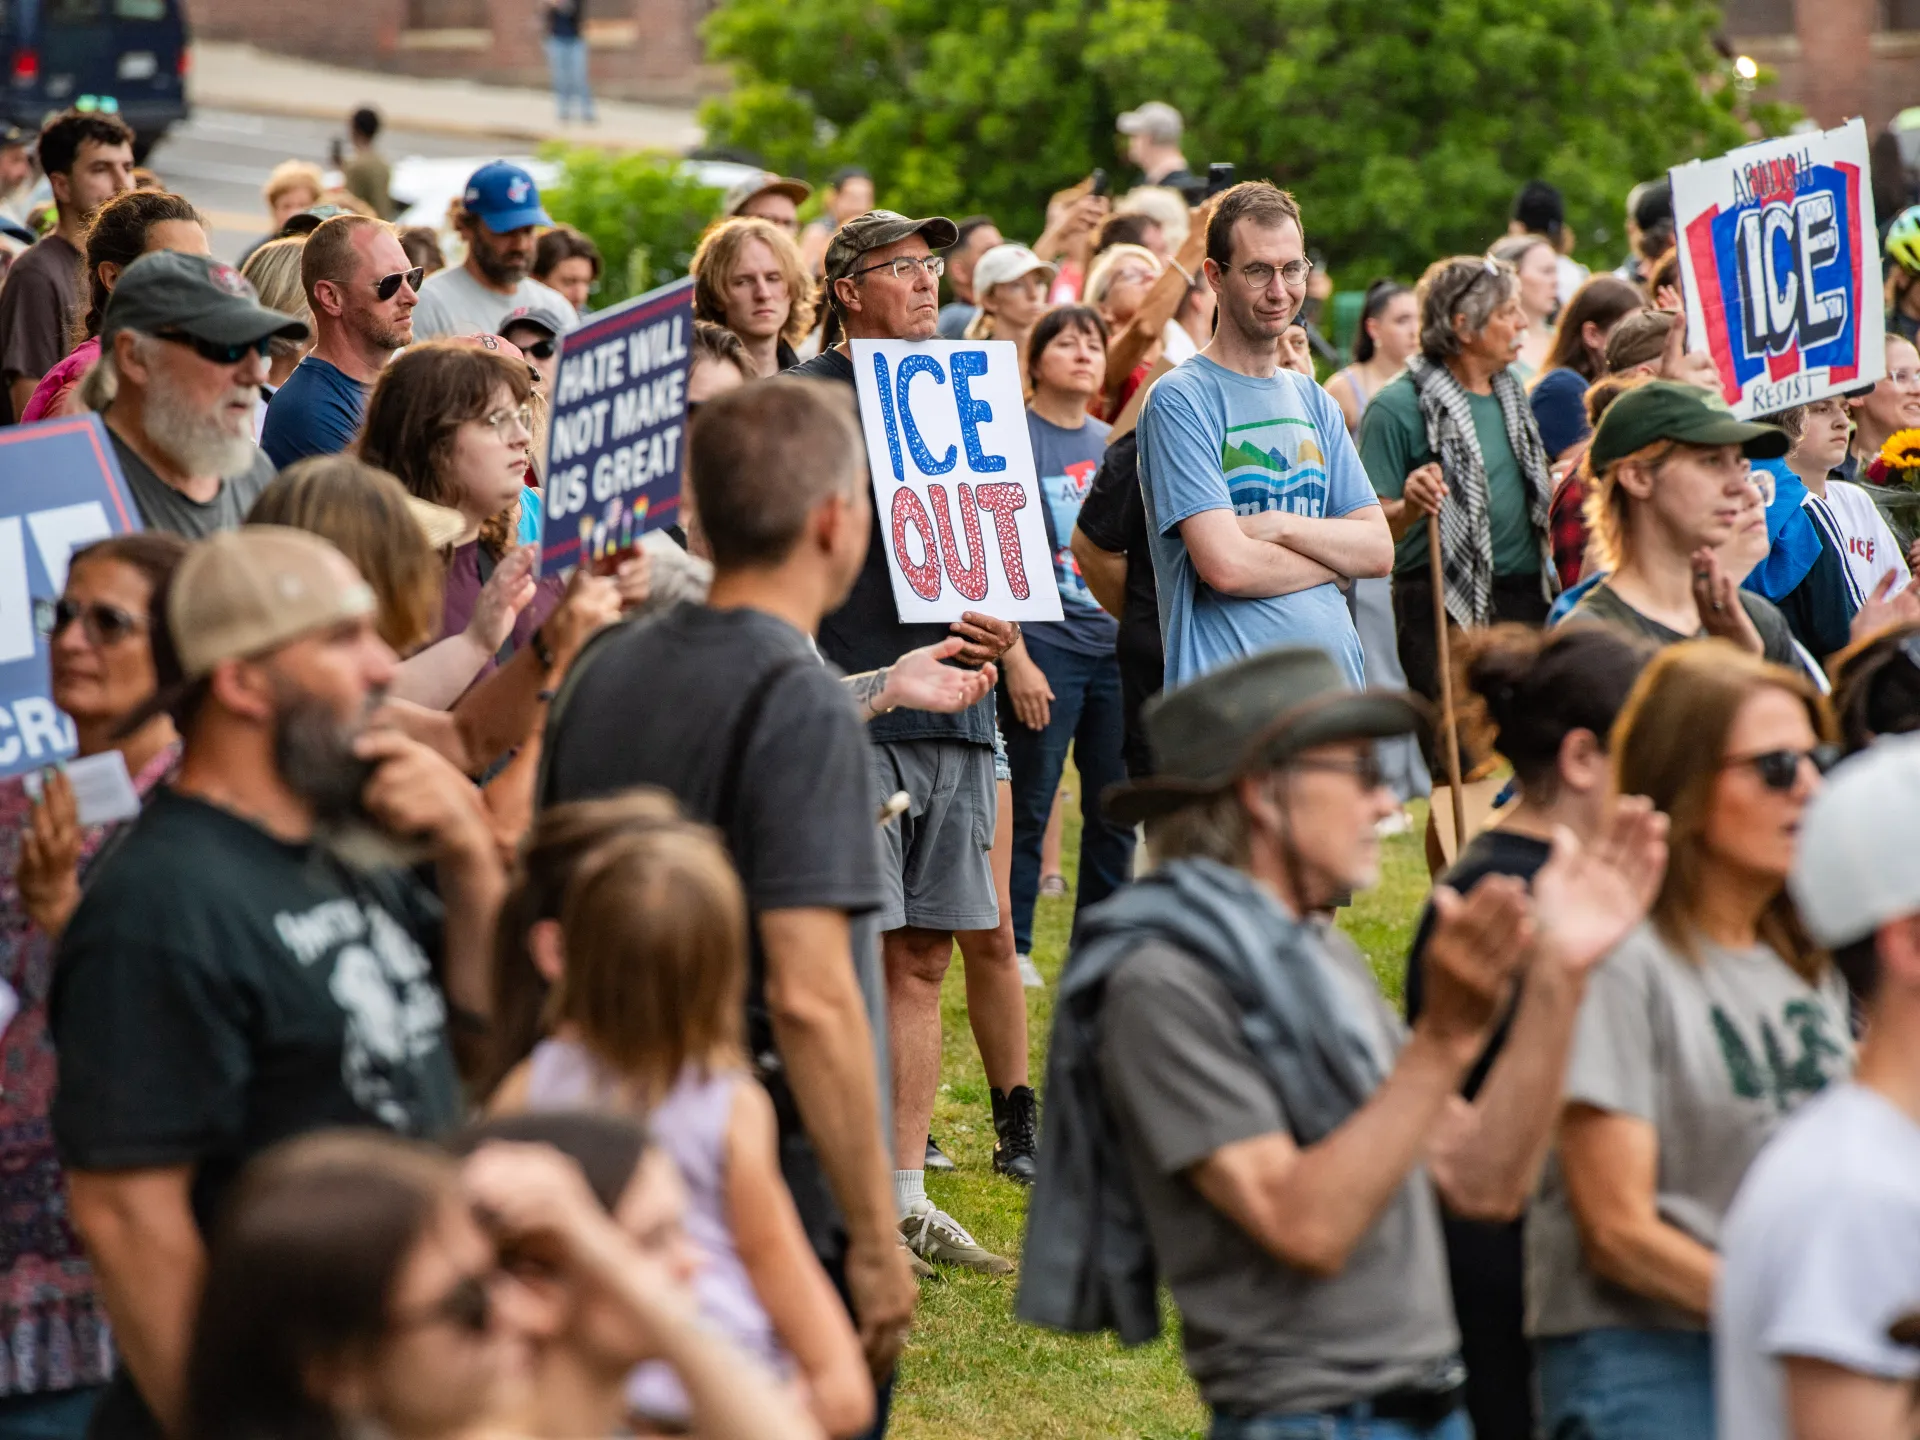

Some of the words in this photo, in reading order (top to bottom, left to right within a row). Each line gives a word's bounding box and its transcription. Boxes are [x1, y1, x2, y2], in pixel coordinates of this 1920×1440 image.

[1736, 190, 1847, 359] ICE
[557, 339, 627, 405] HATE
[628, 314, 688, 378] WILL
[1753, 372, 1828, 411] RESIST
[551, 401, 611, 464] NOT
[611, 369, 684, 440] MAKE
[873, 350, 1006, 482] ICE
[547, 464, 588, 520] US
[591, 424, 682, 502] GREAT
[891, 482, 1029, 601] OUT
